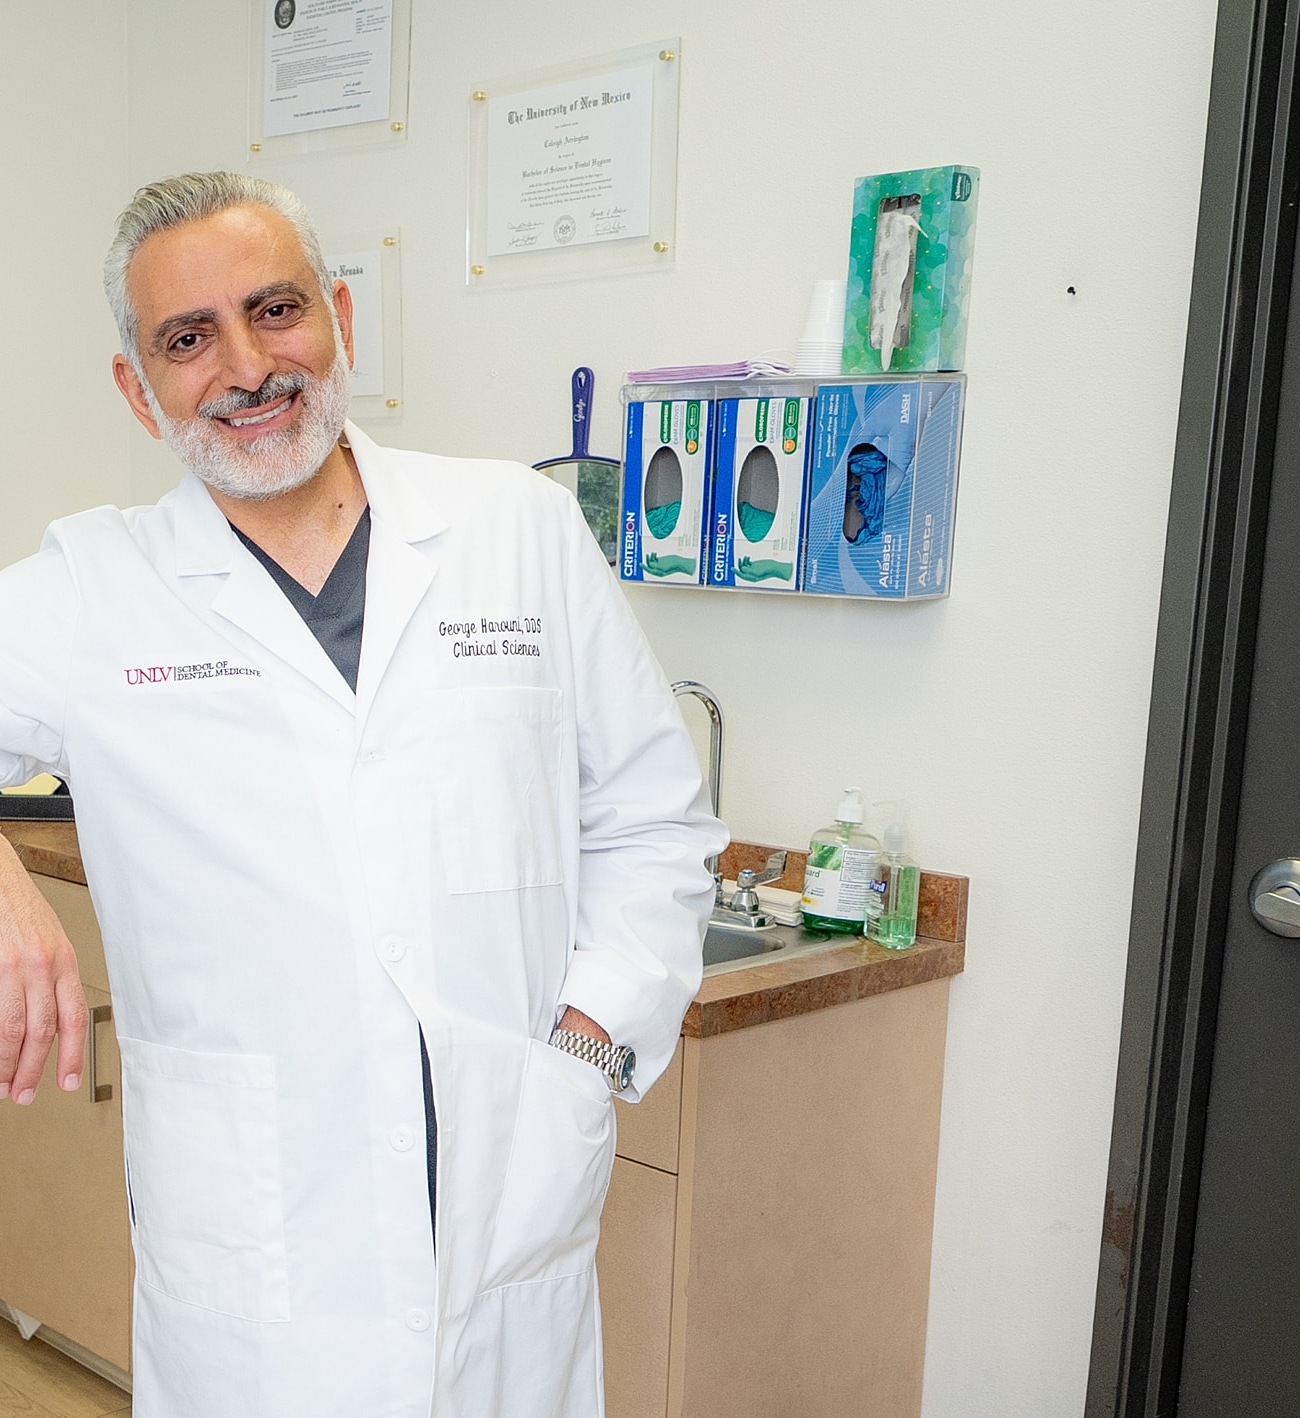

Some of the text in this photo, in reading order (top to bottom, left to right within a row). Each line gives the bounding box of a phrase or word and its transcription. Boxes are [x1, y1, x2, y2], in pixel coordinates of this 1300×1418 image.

[508, 92, 631, 124] The University of New Mexico
[901, 394, 910, 424] DASH
[624, 511, 636, 577] CRITERION
[714, 514, 727, 582] CRITERION
[439, 616, 542, 638] George Harouni, DDS
[454, 640, 540, 658] Clinical Sciences
[124, 666, 173, 685] UNLV
[177, 661, 228, 674] SCHOOL OF
[178, 667, 262, 681] DENTAL MEDICINE
